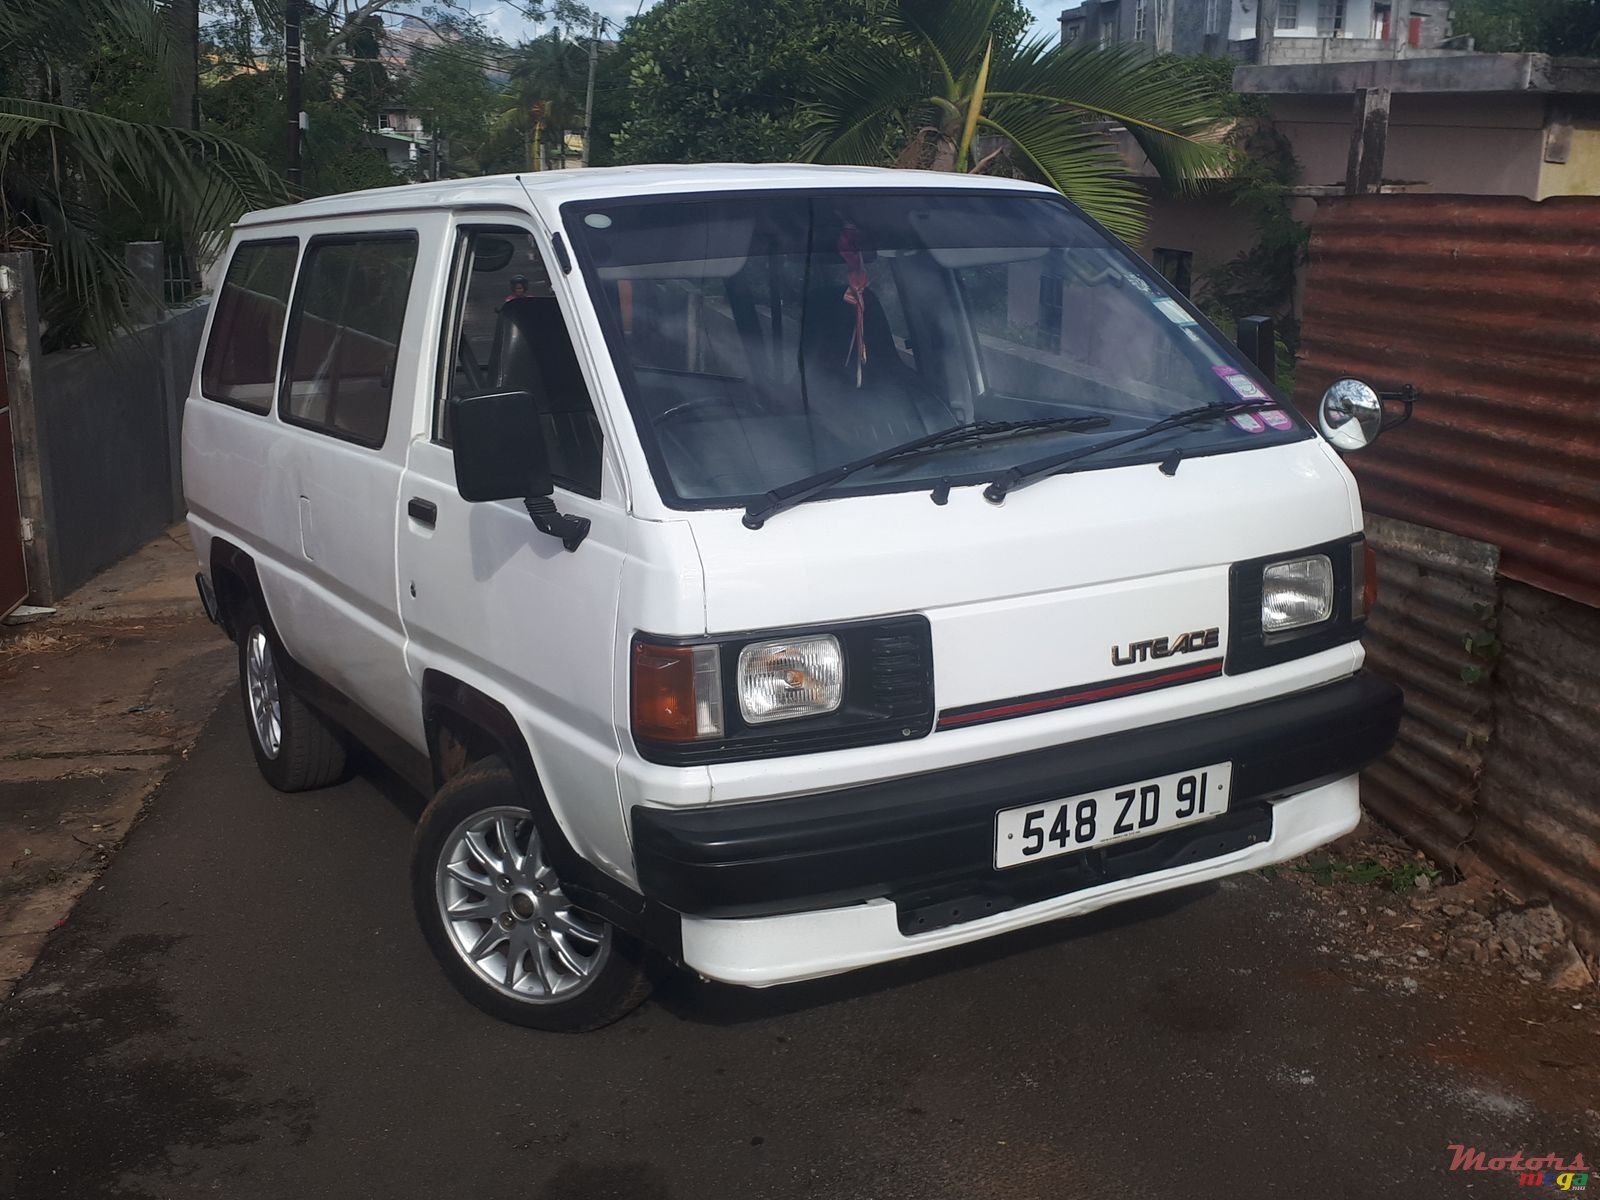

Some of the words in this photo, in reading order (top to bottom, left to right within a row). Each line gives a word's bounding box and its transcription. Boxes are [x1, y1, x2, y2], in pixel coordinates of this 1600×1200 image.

[1111, 627, 1219, 666] LITEACE
[1022, 798, 1097, 856] 548
[1113, 783, 1160, 835] ZD
[1175, 772, 1208, 819] 91
